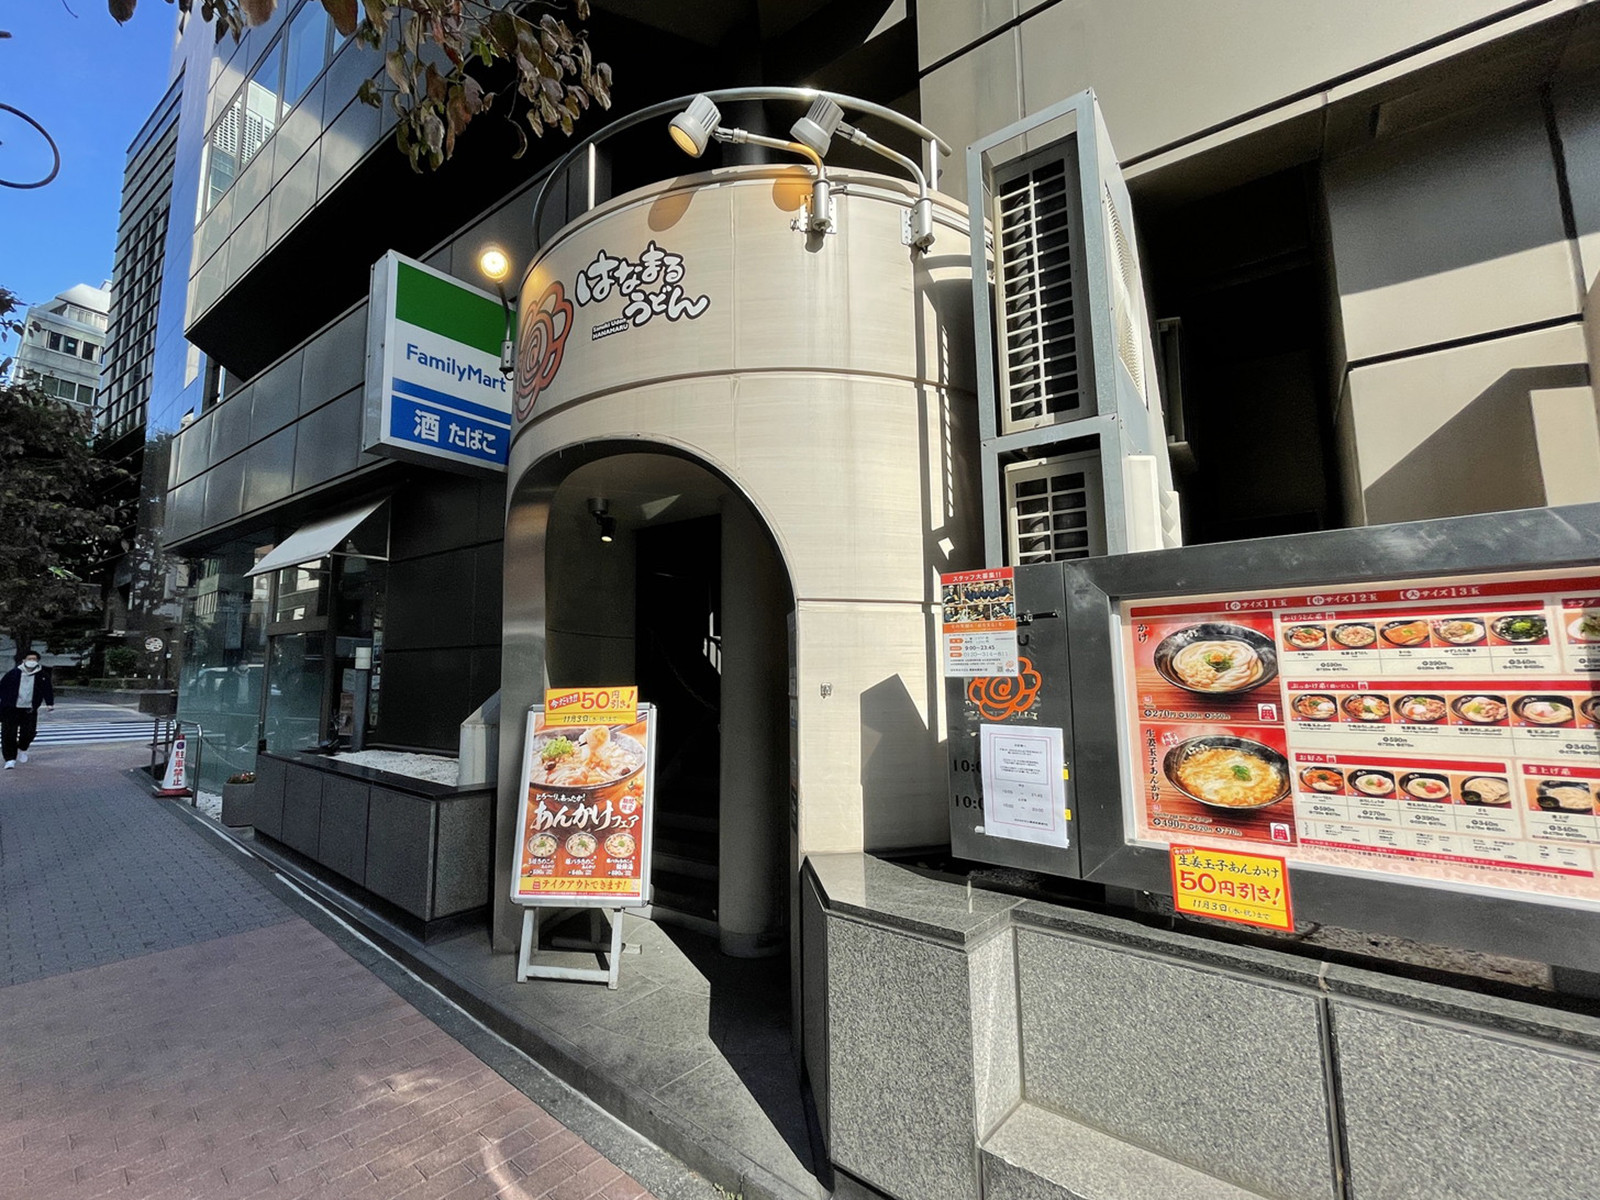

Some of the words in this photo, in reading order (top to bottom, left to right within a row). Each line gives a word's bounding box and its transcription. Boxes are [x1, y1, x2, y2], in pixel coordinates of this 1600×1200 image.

[575, 240, 685, 307] はなまる
[622, 285, 711, 327] うどん
[406, 343, 507, 393] FamilyMart
[413, 409, 440, 443] 酒
[448, 422, 497, 455] たばこ
[173, 750, 185, 786] 駐車禁止
[542, 879, 628, 891] テイクアウトできます!
[1179, 855, 1280, 878] 生姜玉子あんかけ
[1180, 870, 1280, 905] 50円引き!
